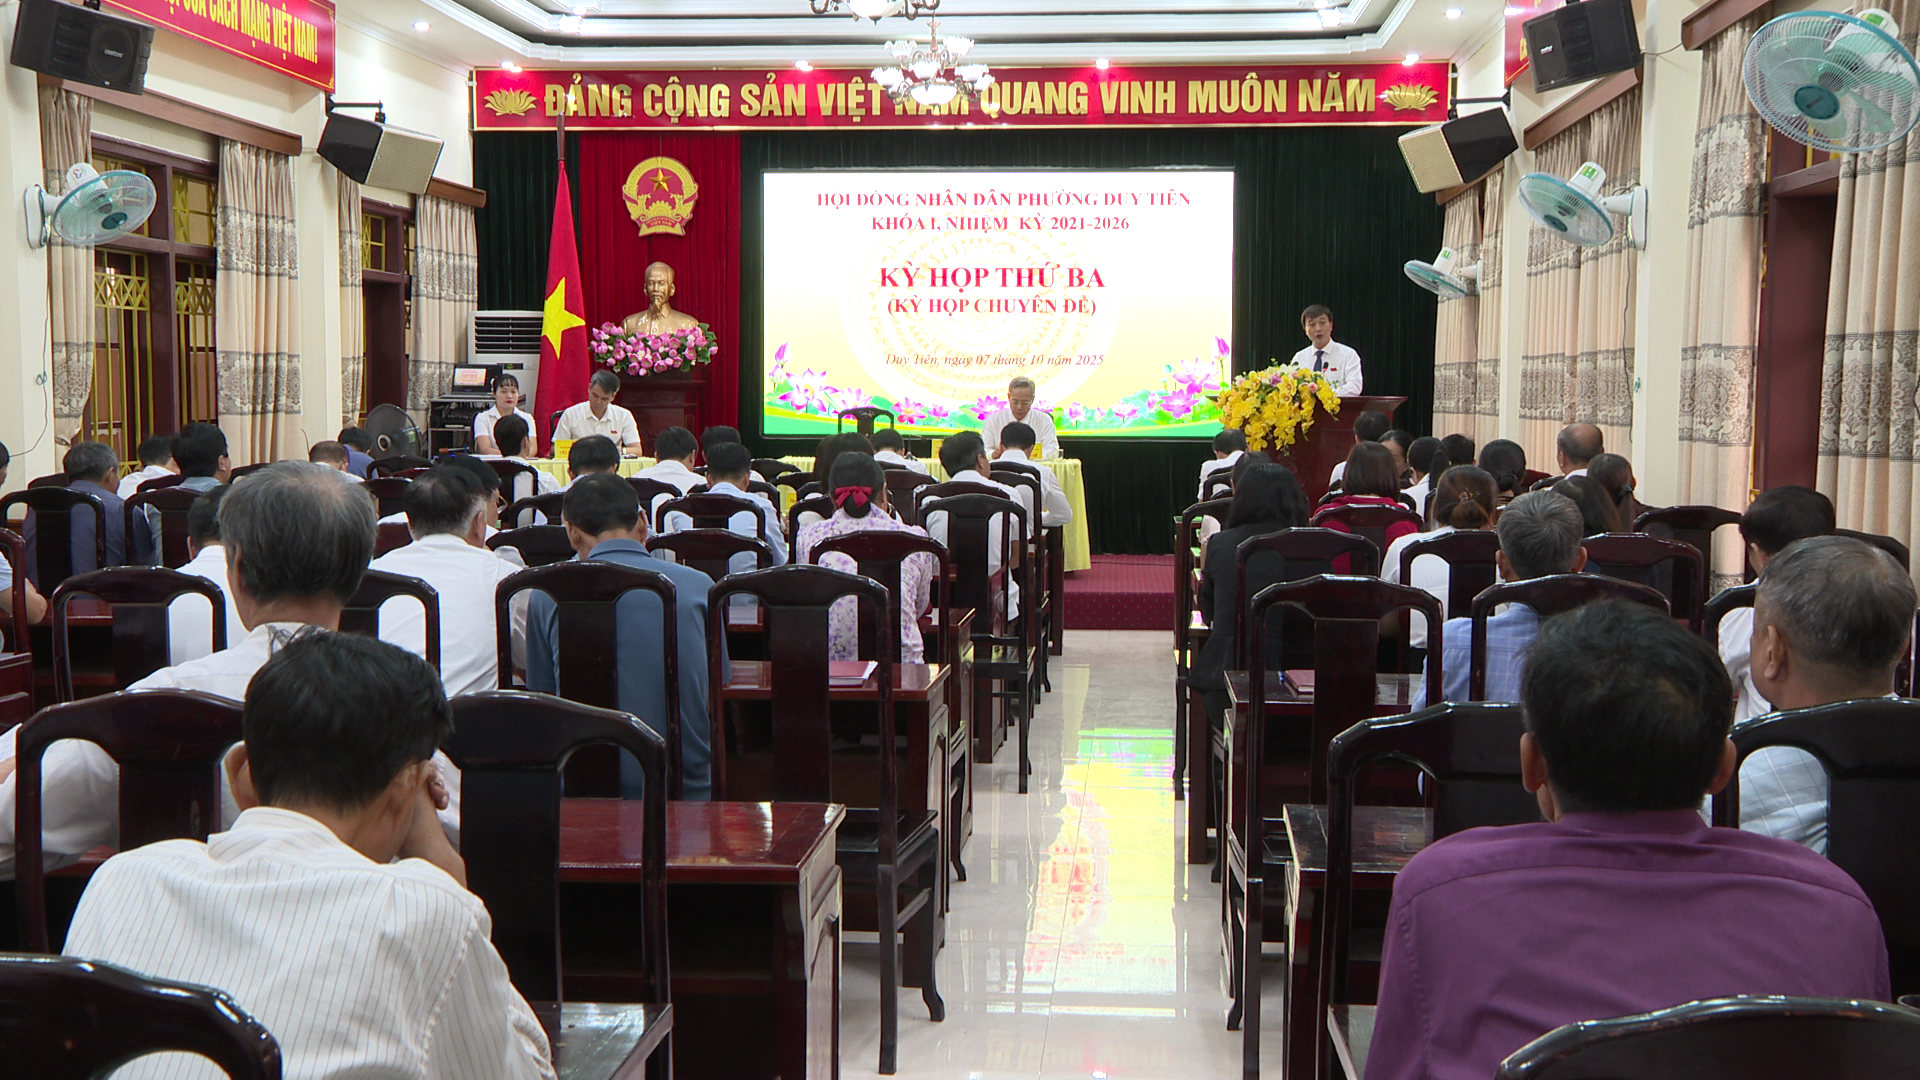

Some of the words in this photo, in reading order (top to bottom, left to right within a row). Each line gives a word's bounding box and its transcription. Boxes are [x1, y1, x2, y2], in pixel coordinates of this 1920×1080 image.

[272, 3, 292, 60] VIỆT
[294, 17, 318, 64] NAM!
[545, 73, 632, 117] ĐẢNG
[643, 76, 731, 123] CỘNG
[741, 72, 807, 117] SẢN
[821, 77, 884, 122] VIỆT
[980, 81, 1088, 118] QUANG
[1099, 80, 1176, 115] VINH
[1187, 73, 1287, 114] MUÔN
[1298, 72, 1376, 113] NĂM
[915, 188, 968, 207] NHÂN
[973, 188, 1012, 206] DÂN
[1017, 188, 1098, 207] PHƯỜNG
[1103, 192, 1142, 206] DUY
[1147, 188, 1190, 206] TIÊN
[872, 212, 926, 231] KHÓA
[1019, 212, 1046, 231] KỲ
[1050, 216, 1130, 231] 2021-2026
[880, 260, 921, 288] KỲ
[928, 267, 990, 293] HỌP
[995, 261, 1061, 288] THỨ
[1065, 267, 1106, 288] BA
[887, 294, 923, 316] (KỲ
[929, 298, 970, 317] HỌP
[973, 294, 1057, 314] CHUYÊN
[885, 353, 910, 368] Duy
[944, 354, 973, 368] ngày
[975, 354, 990, 366] 07
[993, 353, 1027, 368] tháng
[1030, 354, 1044, 366] 10
[1047, 353, 1072, 366] năm
[1075, 354, 1105, 366] 2025
